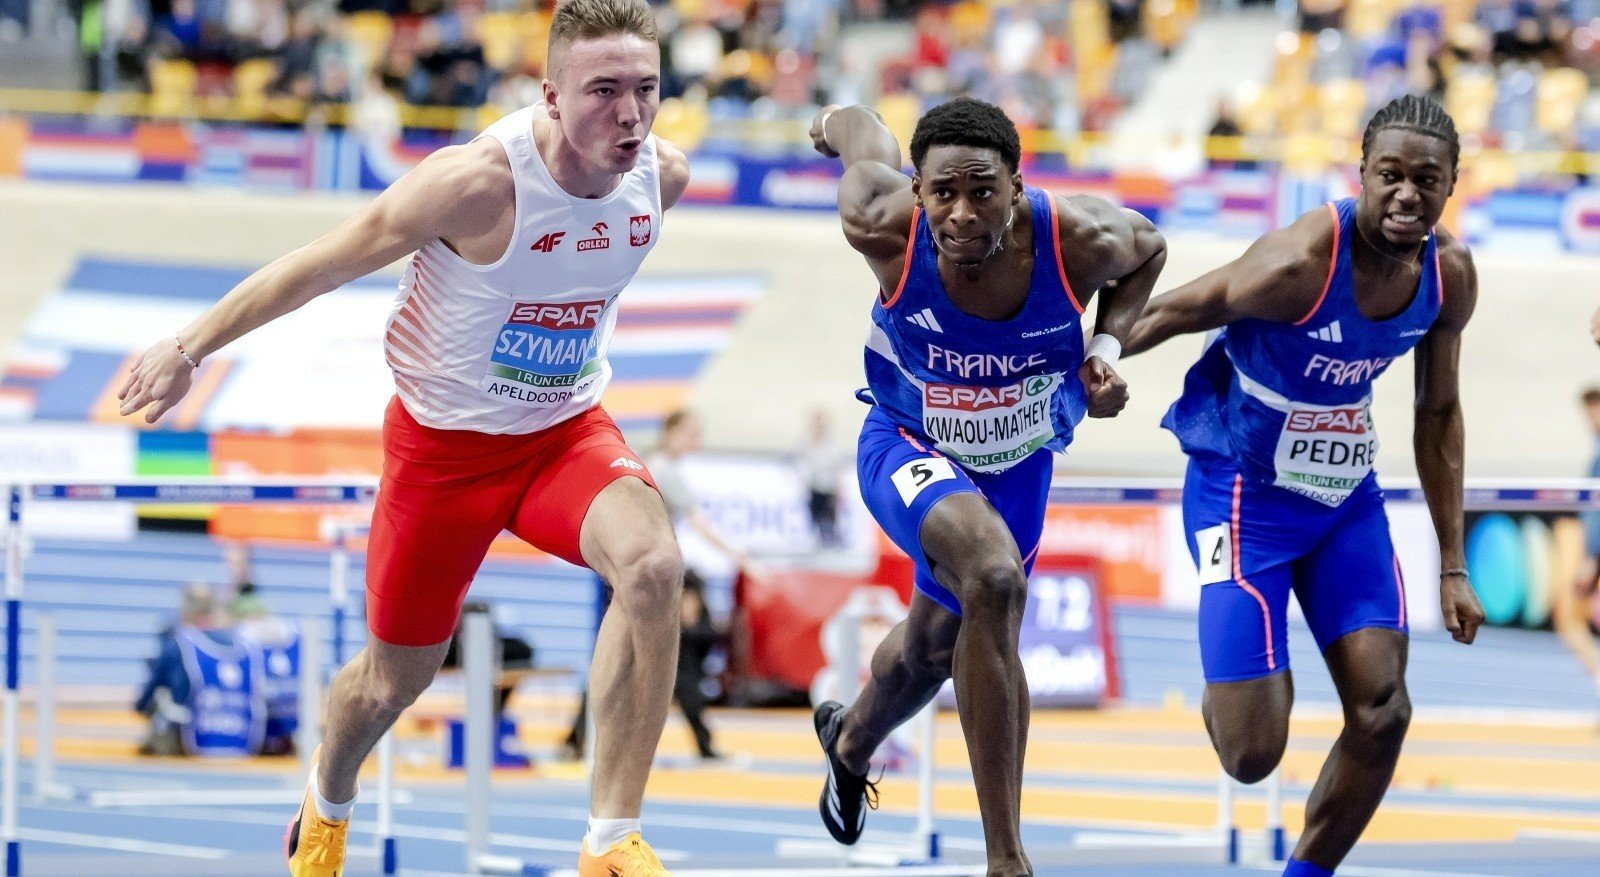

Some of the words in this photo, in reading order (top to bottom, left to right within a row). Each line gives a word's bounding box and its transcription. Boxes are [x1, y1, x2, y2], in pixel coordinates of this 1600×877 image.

[531, 231, 566, 252] 4F
[578, 240, 608, 250] ORLEN
[512, 305, 600, 327] SPAR
[496, 329, 598, 366] SZYMAN
[927, 343, 1047, 378] FRANCE
[524, 373, 551, 387] RUN
[928, 382, 1023, 408] SPAR
[926, 398, 1048, 445] KWAOU-MATHEY
[1290, 411, 1365, 431] SPAR
[910, 463, 934, 487] 5
[1303, 475, 1330, 487] RUN
[1211, 536, 1224, 566] 4
